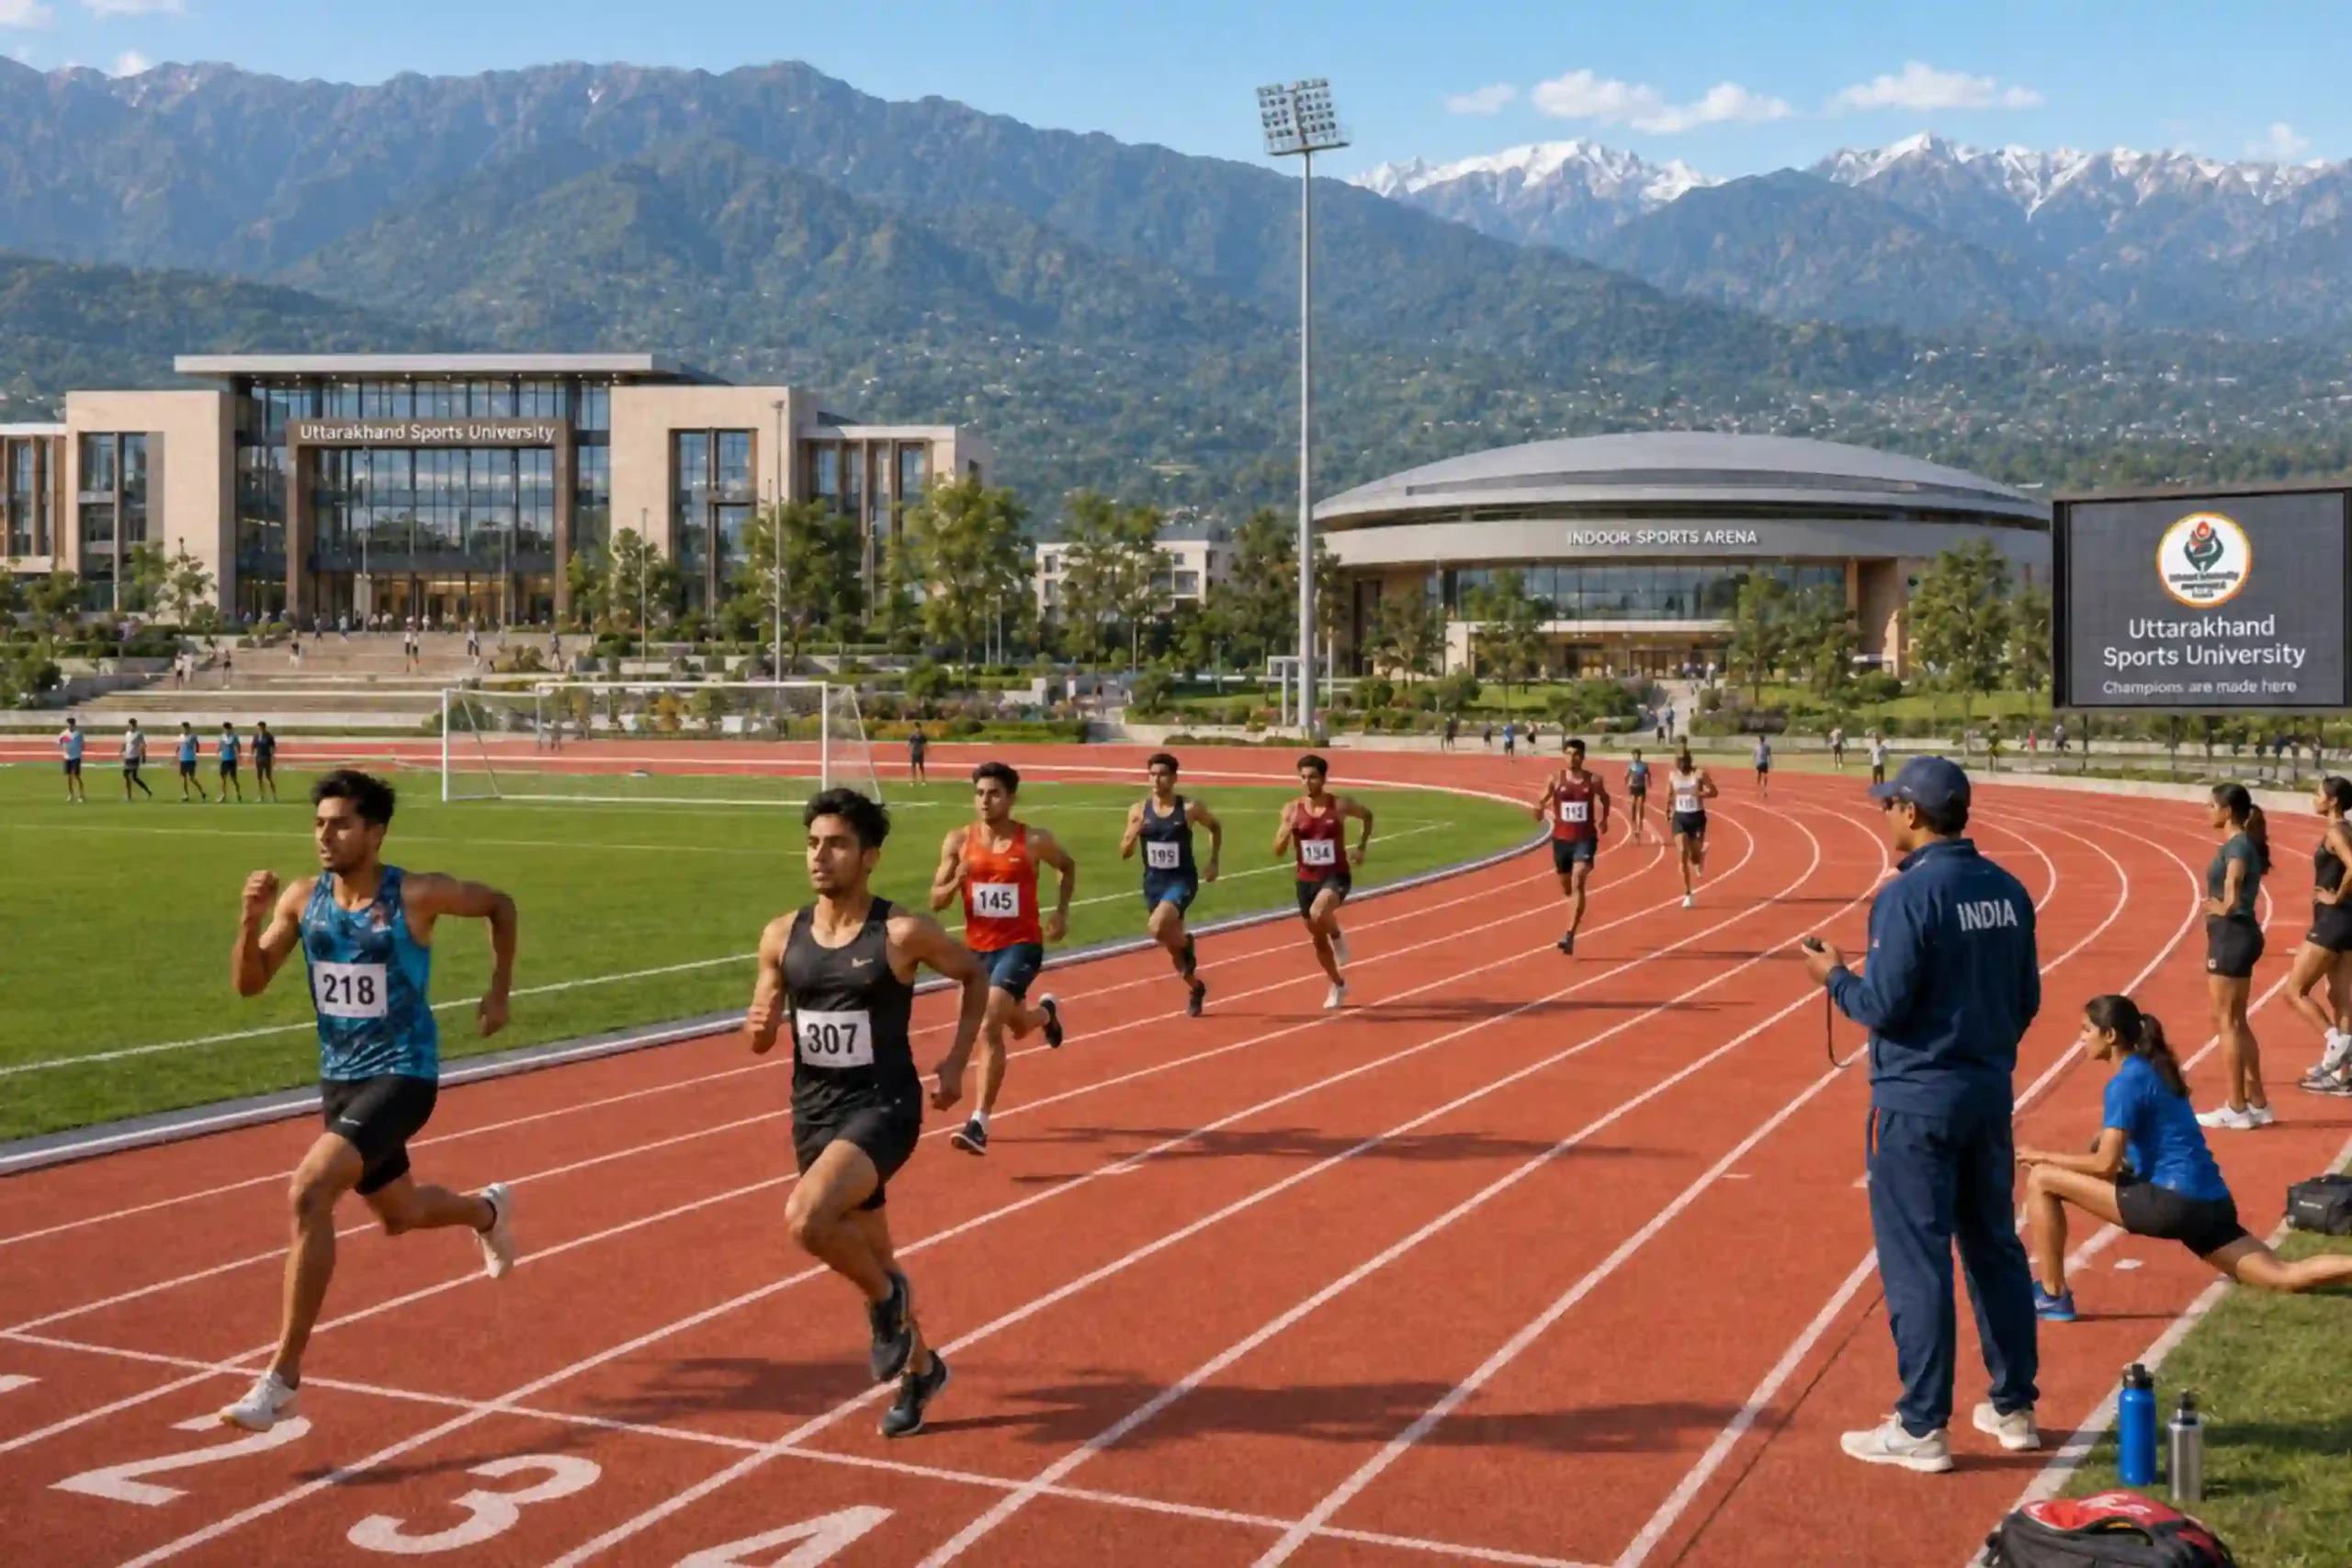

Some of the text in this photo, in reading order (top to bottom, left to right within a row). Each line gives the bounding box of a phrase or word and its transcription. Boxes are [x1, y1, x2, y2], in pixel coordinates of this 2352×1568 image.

[300, 423, 555, 444] Uttarakhand Sports University
[1567, 529, 1758, 545] INDOOR SPORTS ARENA
[2129, 614, 2276, 639] Uttarakhand
[2103, 643, 2307, 671] Sports University
[2102, 677, 2297, 695] Champions are made here
[979, 891, 1012, 910] 145
[1956, 897, 2018, 931] INDIA
[322, 973, 375, 1005] 218
[807, 1023, 858, 1055] 307
[346, 1453, 603, 1554] 3
